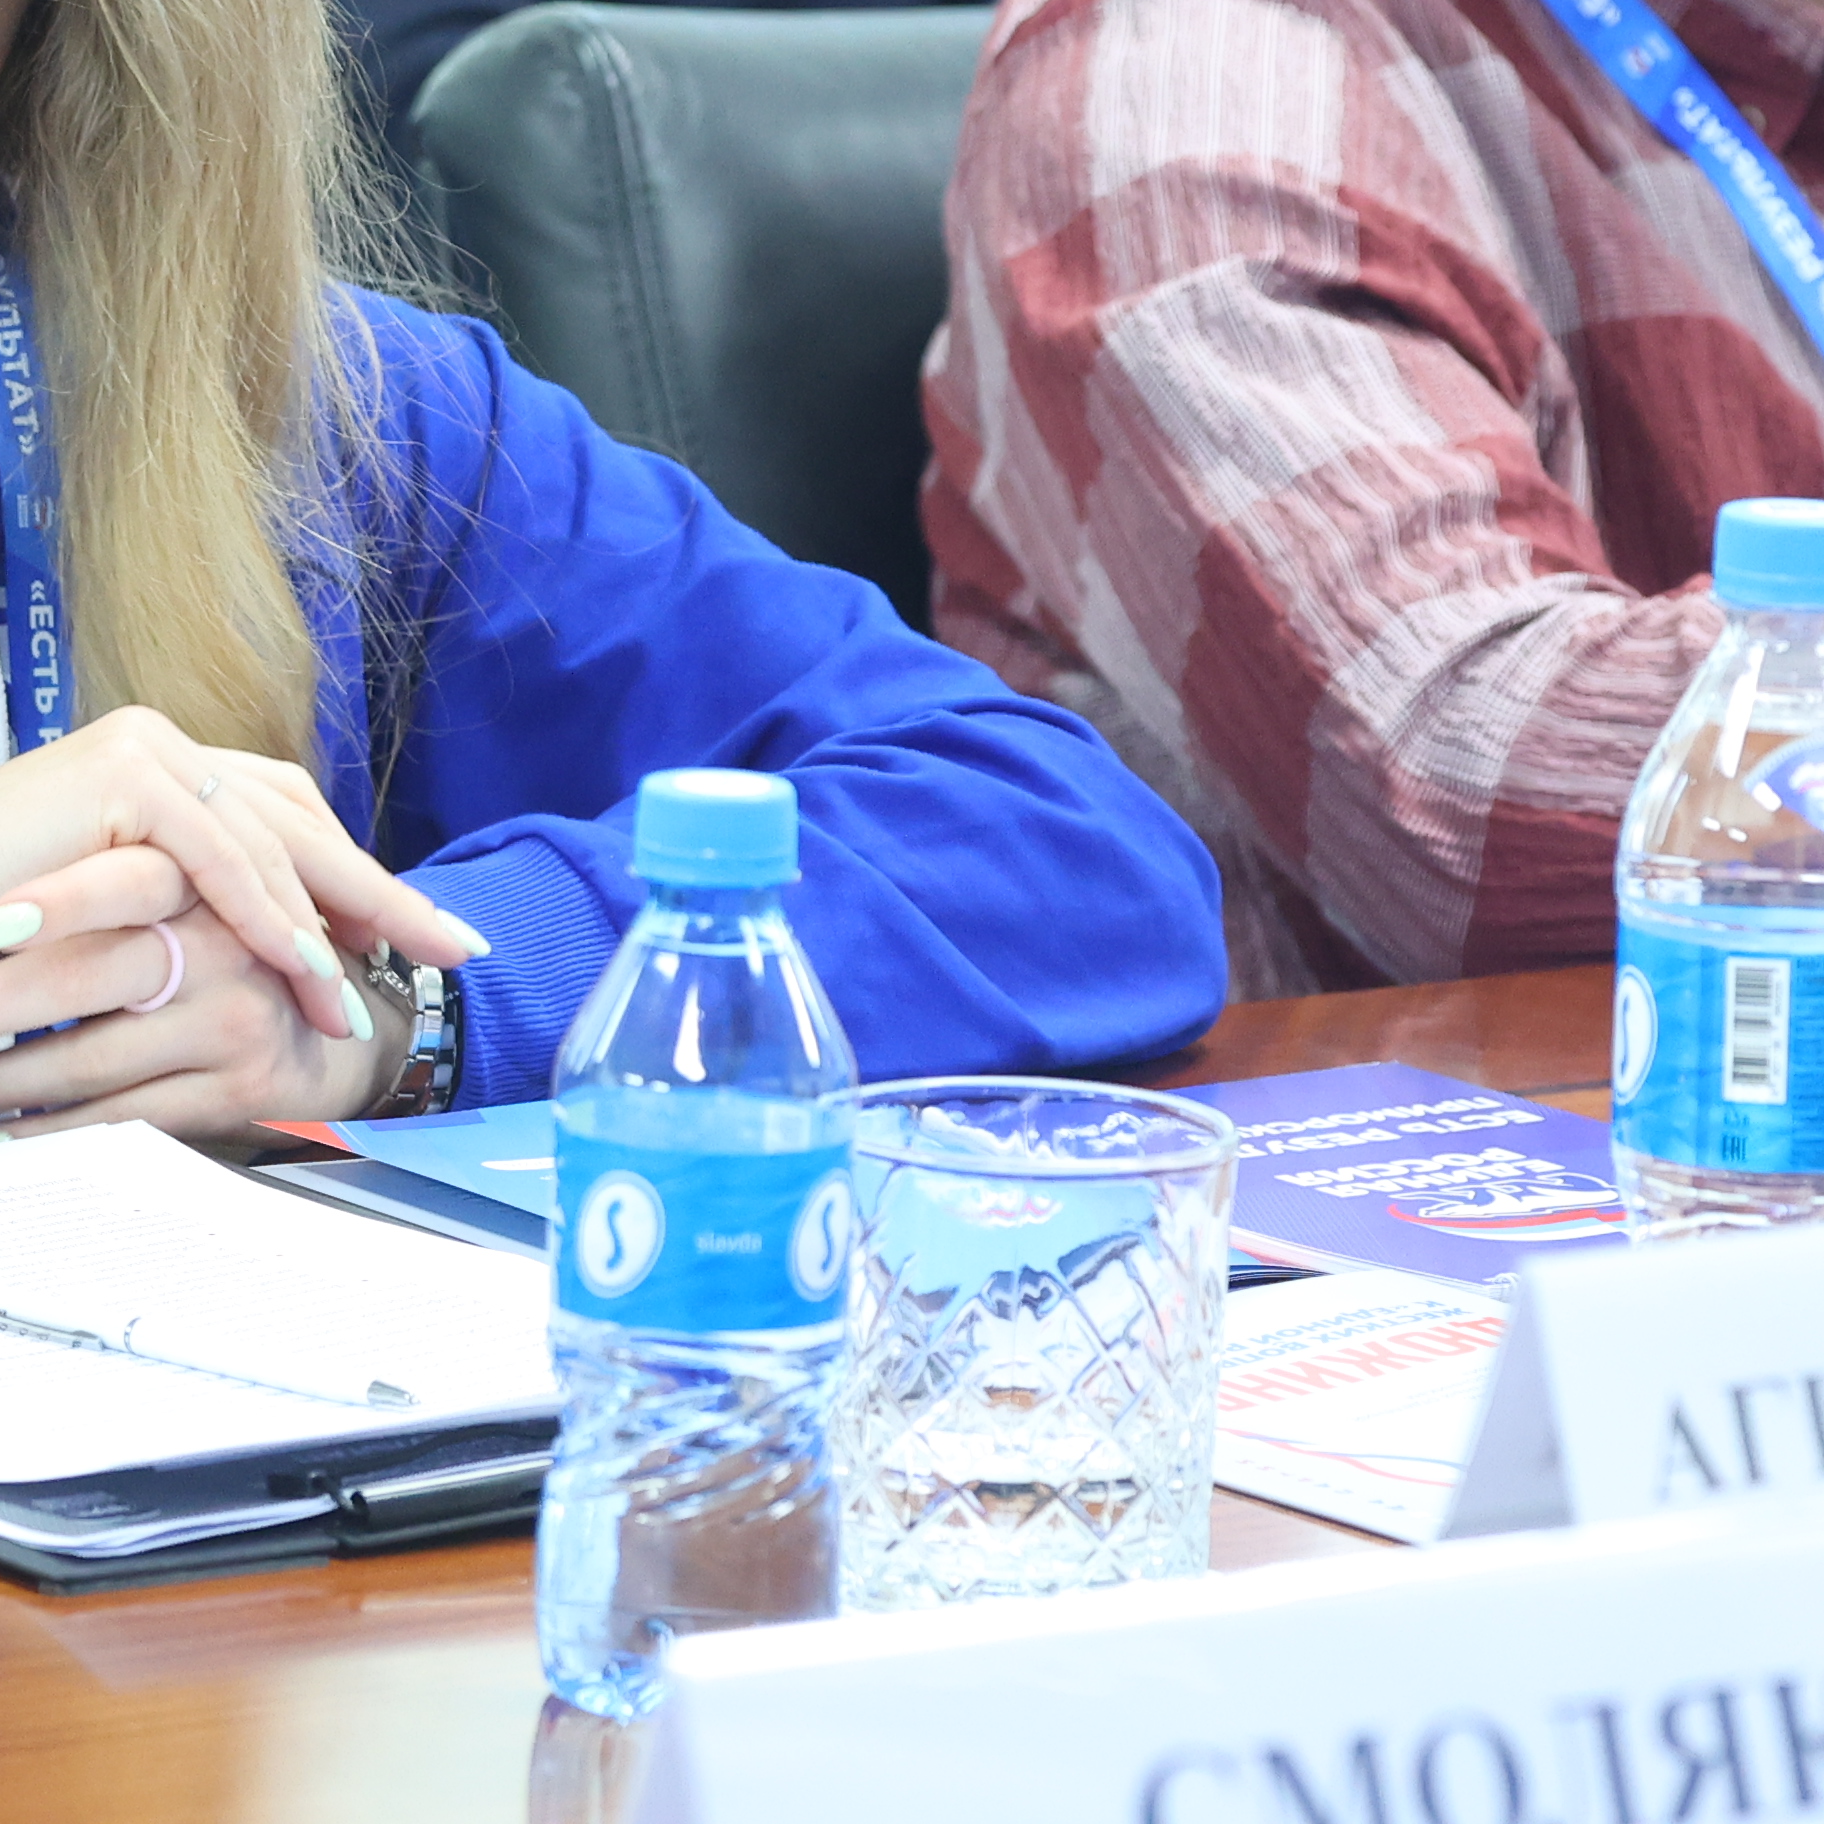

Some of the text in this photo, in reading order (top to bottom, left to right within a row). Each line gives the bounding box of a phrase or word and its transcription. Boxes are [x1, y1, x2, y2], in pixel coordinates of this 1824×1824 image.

[1237, 1109, 1545, 1158] ЕСТЬ РЕЗУЛ
[1274, 1147, 1527, 1187] РОССИЯ
[1316, 1159, 1565, 1198] ЕДИНАЯ
[1222, 1307, 1473, 1368] ЖЕСТКИХ ВОПР
